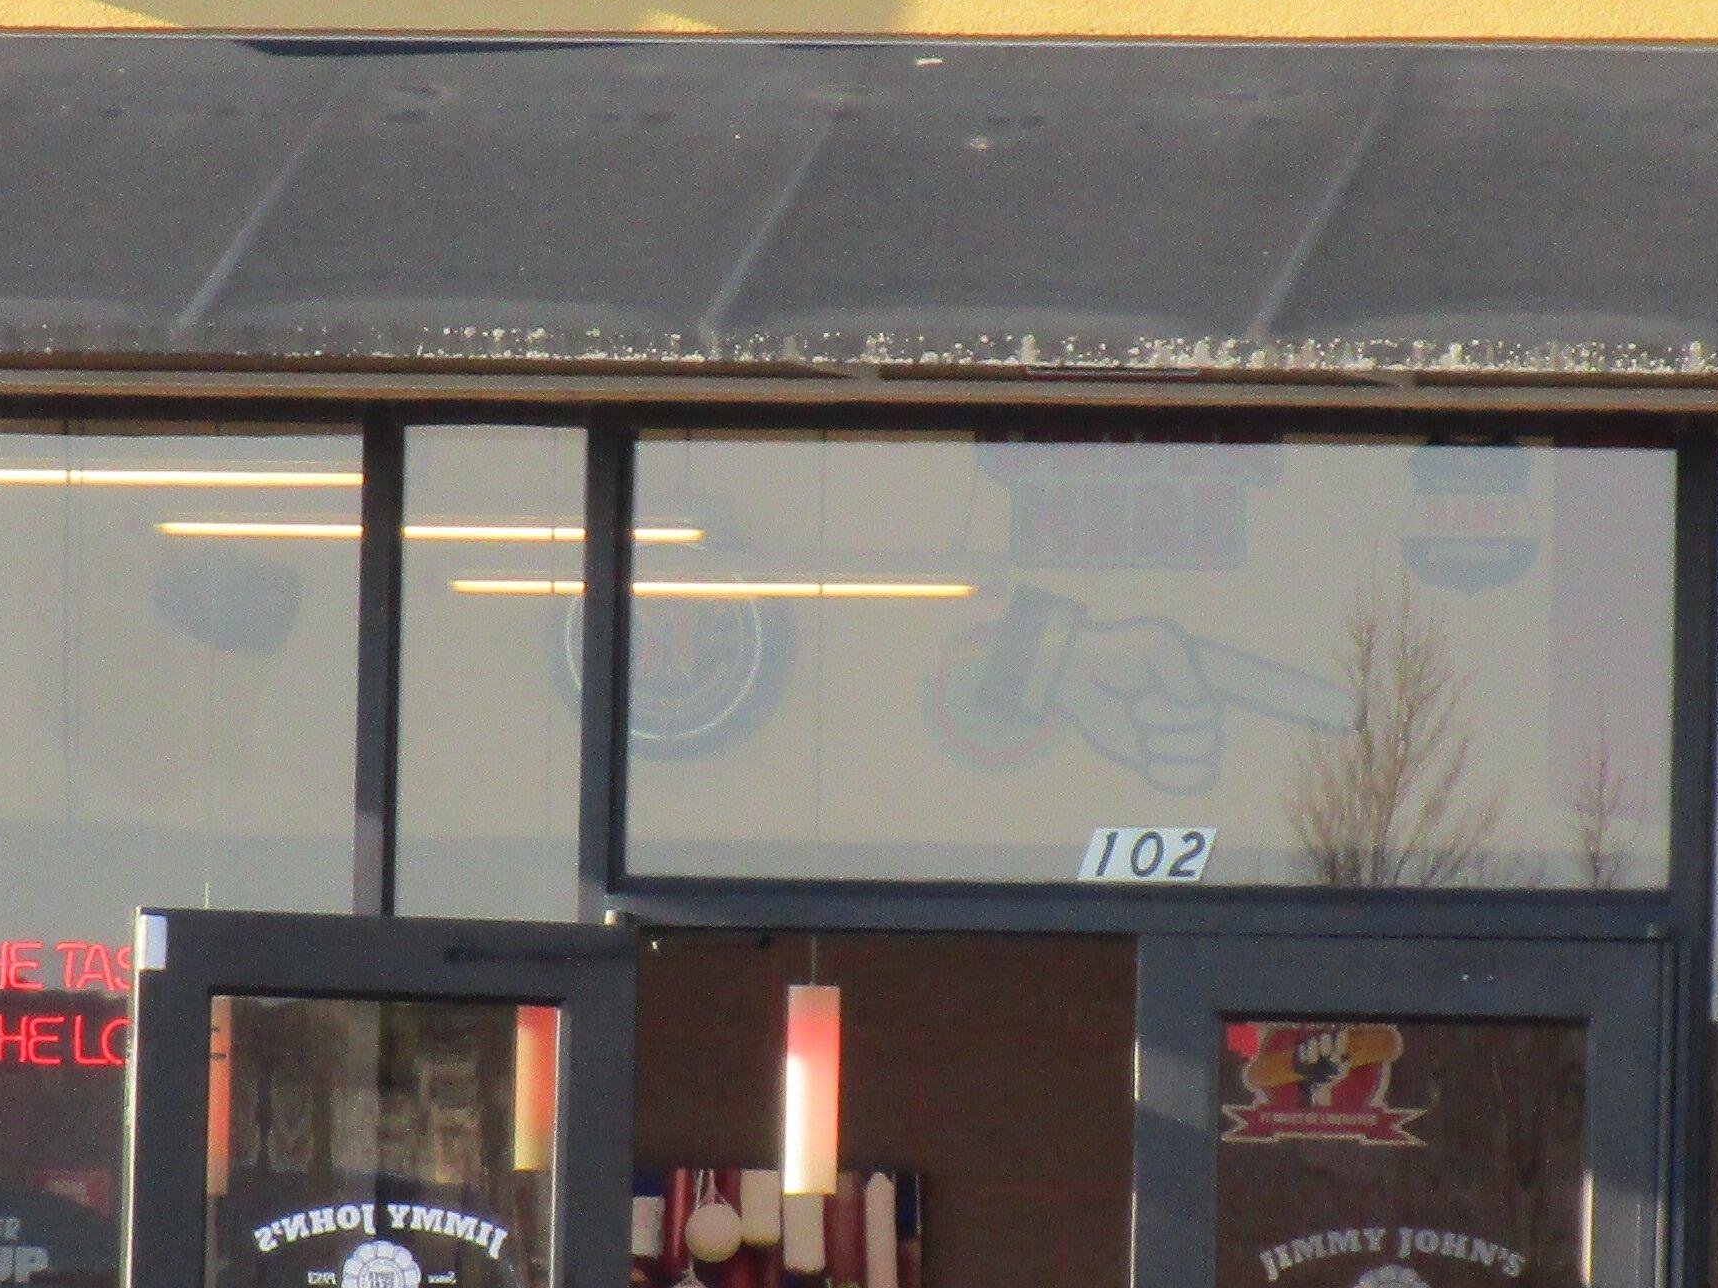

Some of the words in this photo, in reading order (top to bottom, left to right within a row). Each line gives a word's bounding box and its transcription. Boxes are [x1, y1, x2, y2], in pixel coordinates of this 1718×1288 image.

[1095, 829, 1208, 878] 102
[1259, 1227, 1387, 1282] JIMMY
[1398, 1226, 1527, 1279] JOHN'S
